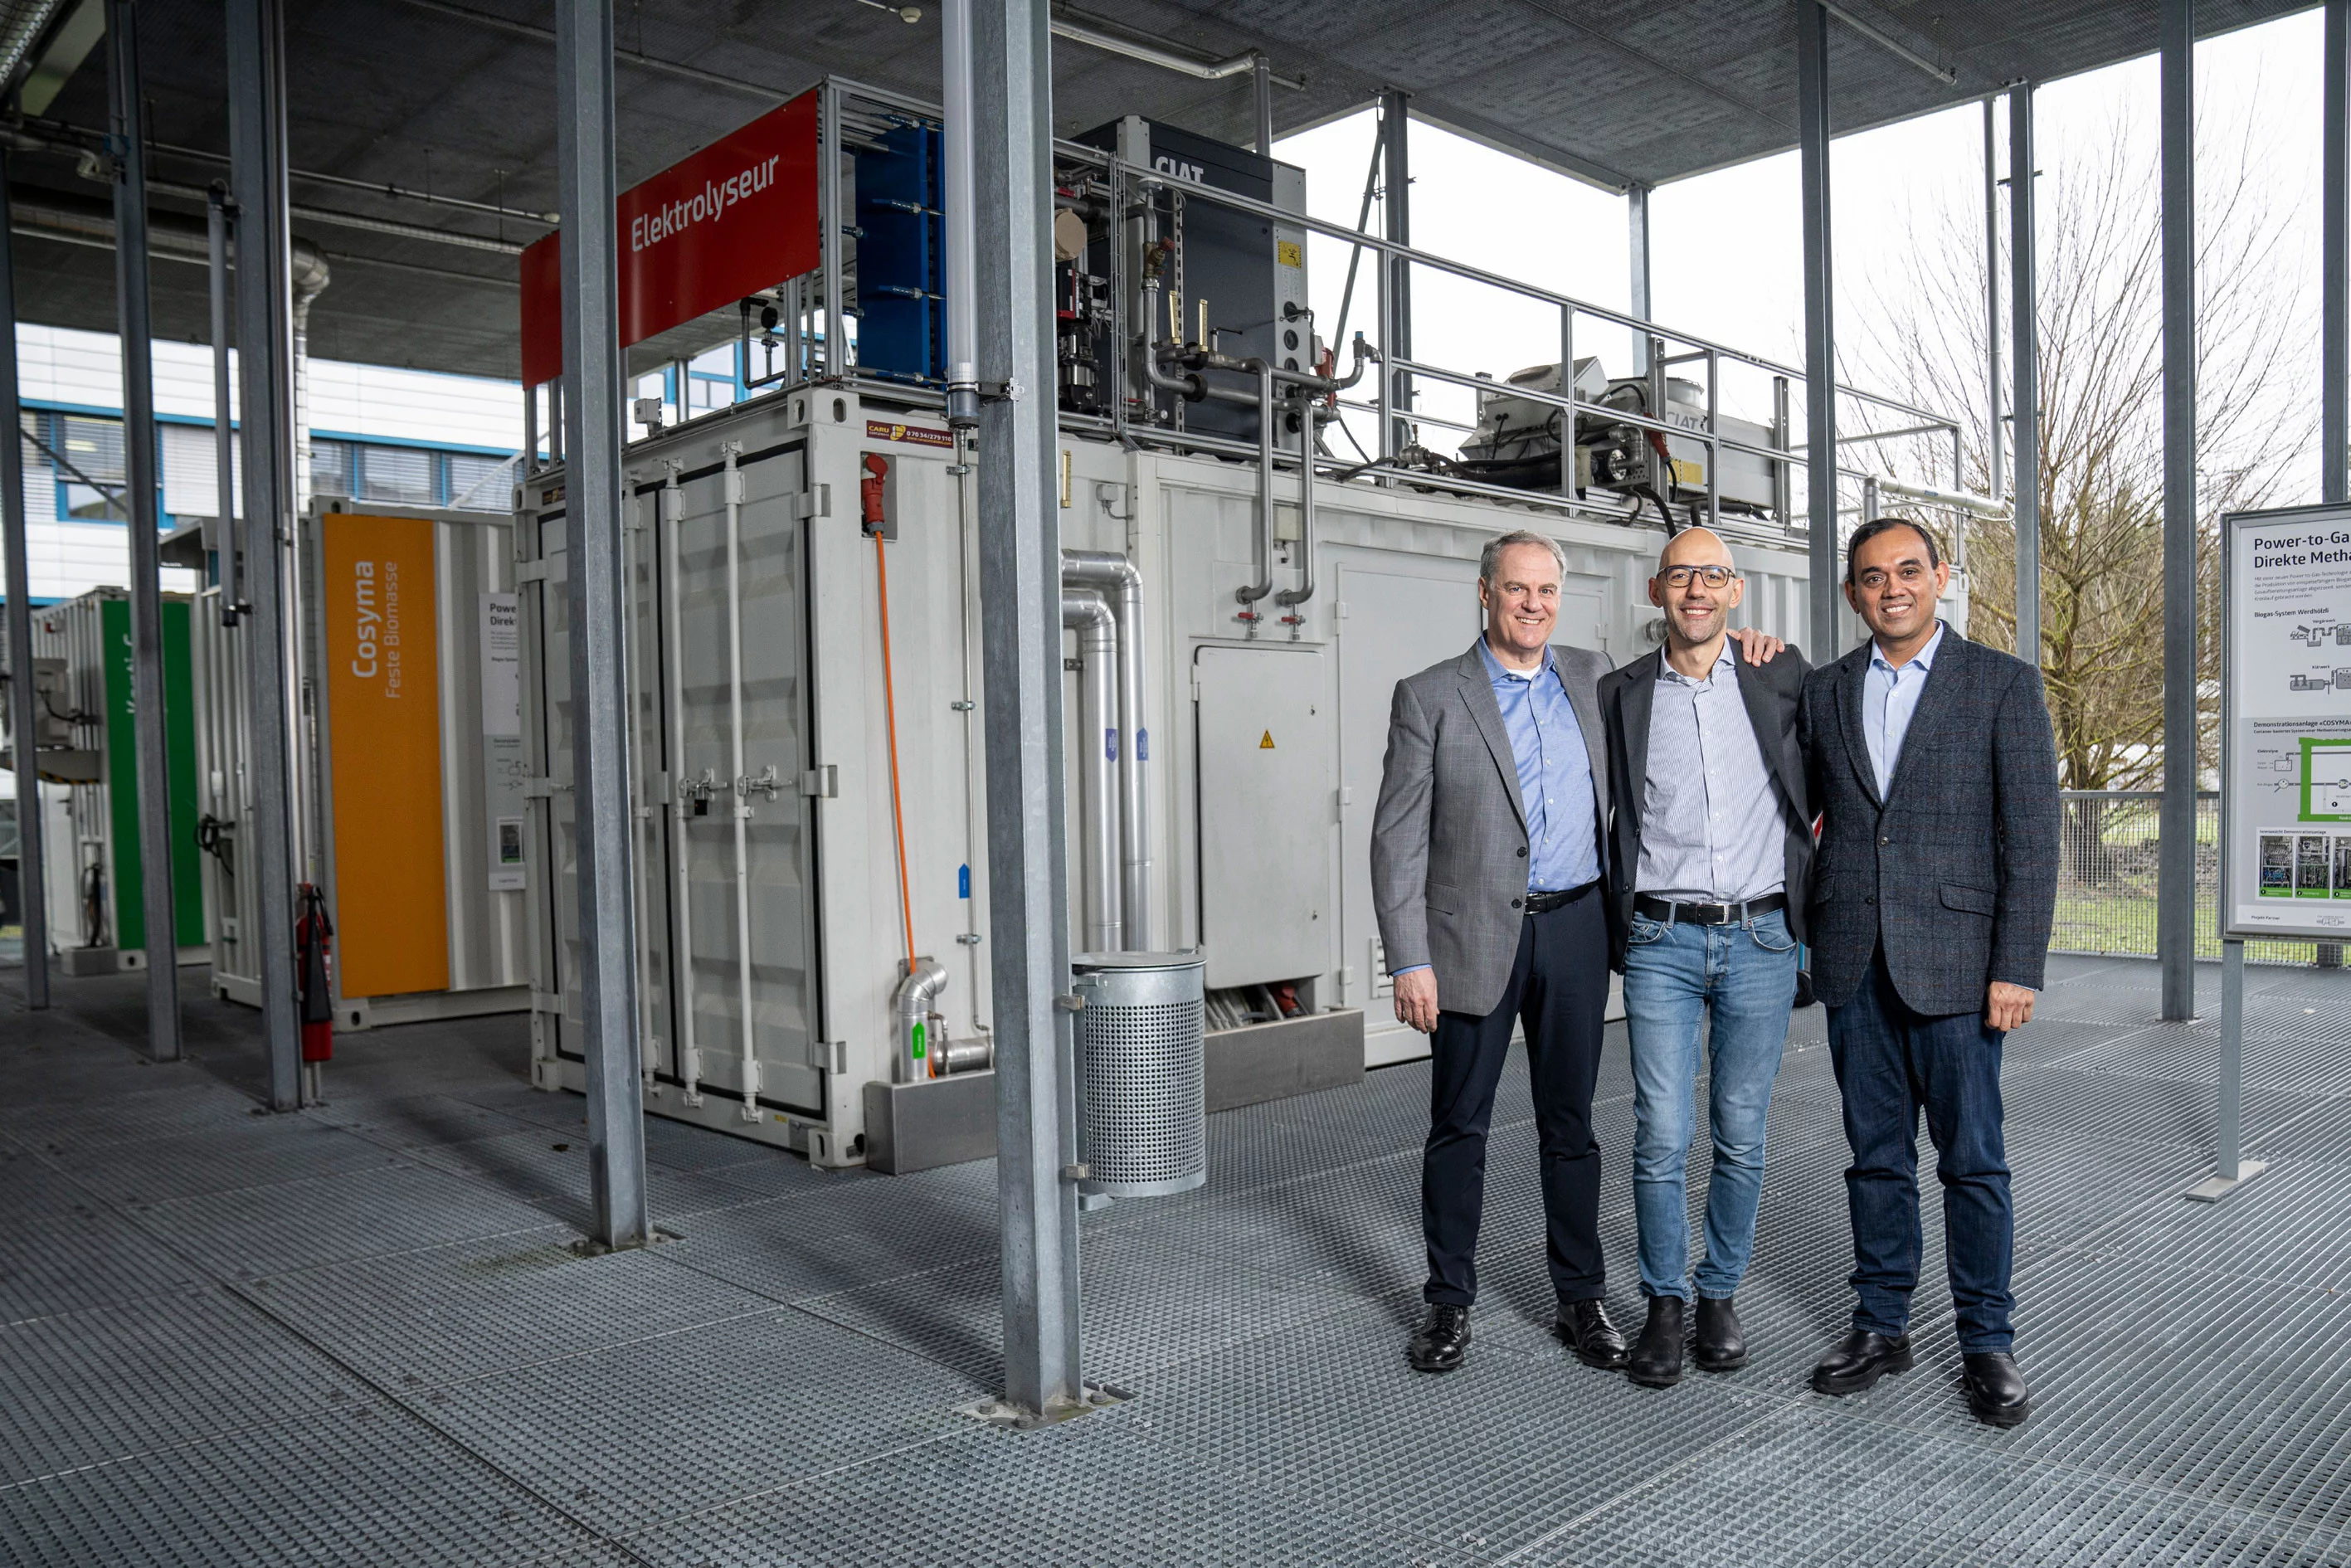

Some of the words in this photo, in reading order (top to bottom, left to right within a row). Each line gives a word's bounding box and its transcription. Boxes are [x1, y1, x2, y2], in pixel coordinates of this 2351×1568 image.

[1156, 156, 1204, 183] CIAT
[631, 154, 779, 252] Elektrolyseur
[1667, 411, 1699, 430] IAT
[920, 432, 941, 441] 34/279
[2254, 531, 2349, 550] Power-to-Ga
[2254, 553, 2306, 568] Direkte
[382, 561, 401, 647] Biomasse
[489, 602, 516, 613] Powe
[352, 560, 382, 678] Cosyma
[489, 616, 518, 626] Direk
[385, 650, 402, 699] Feste
